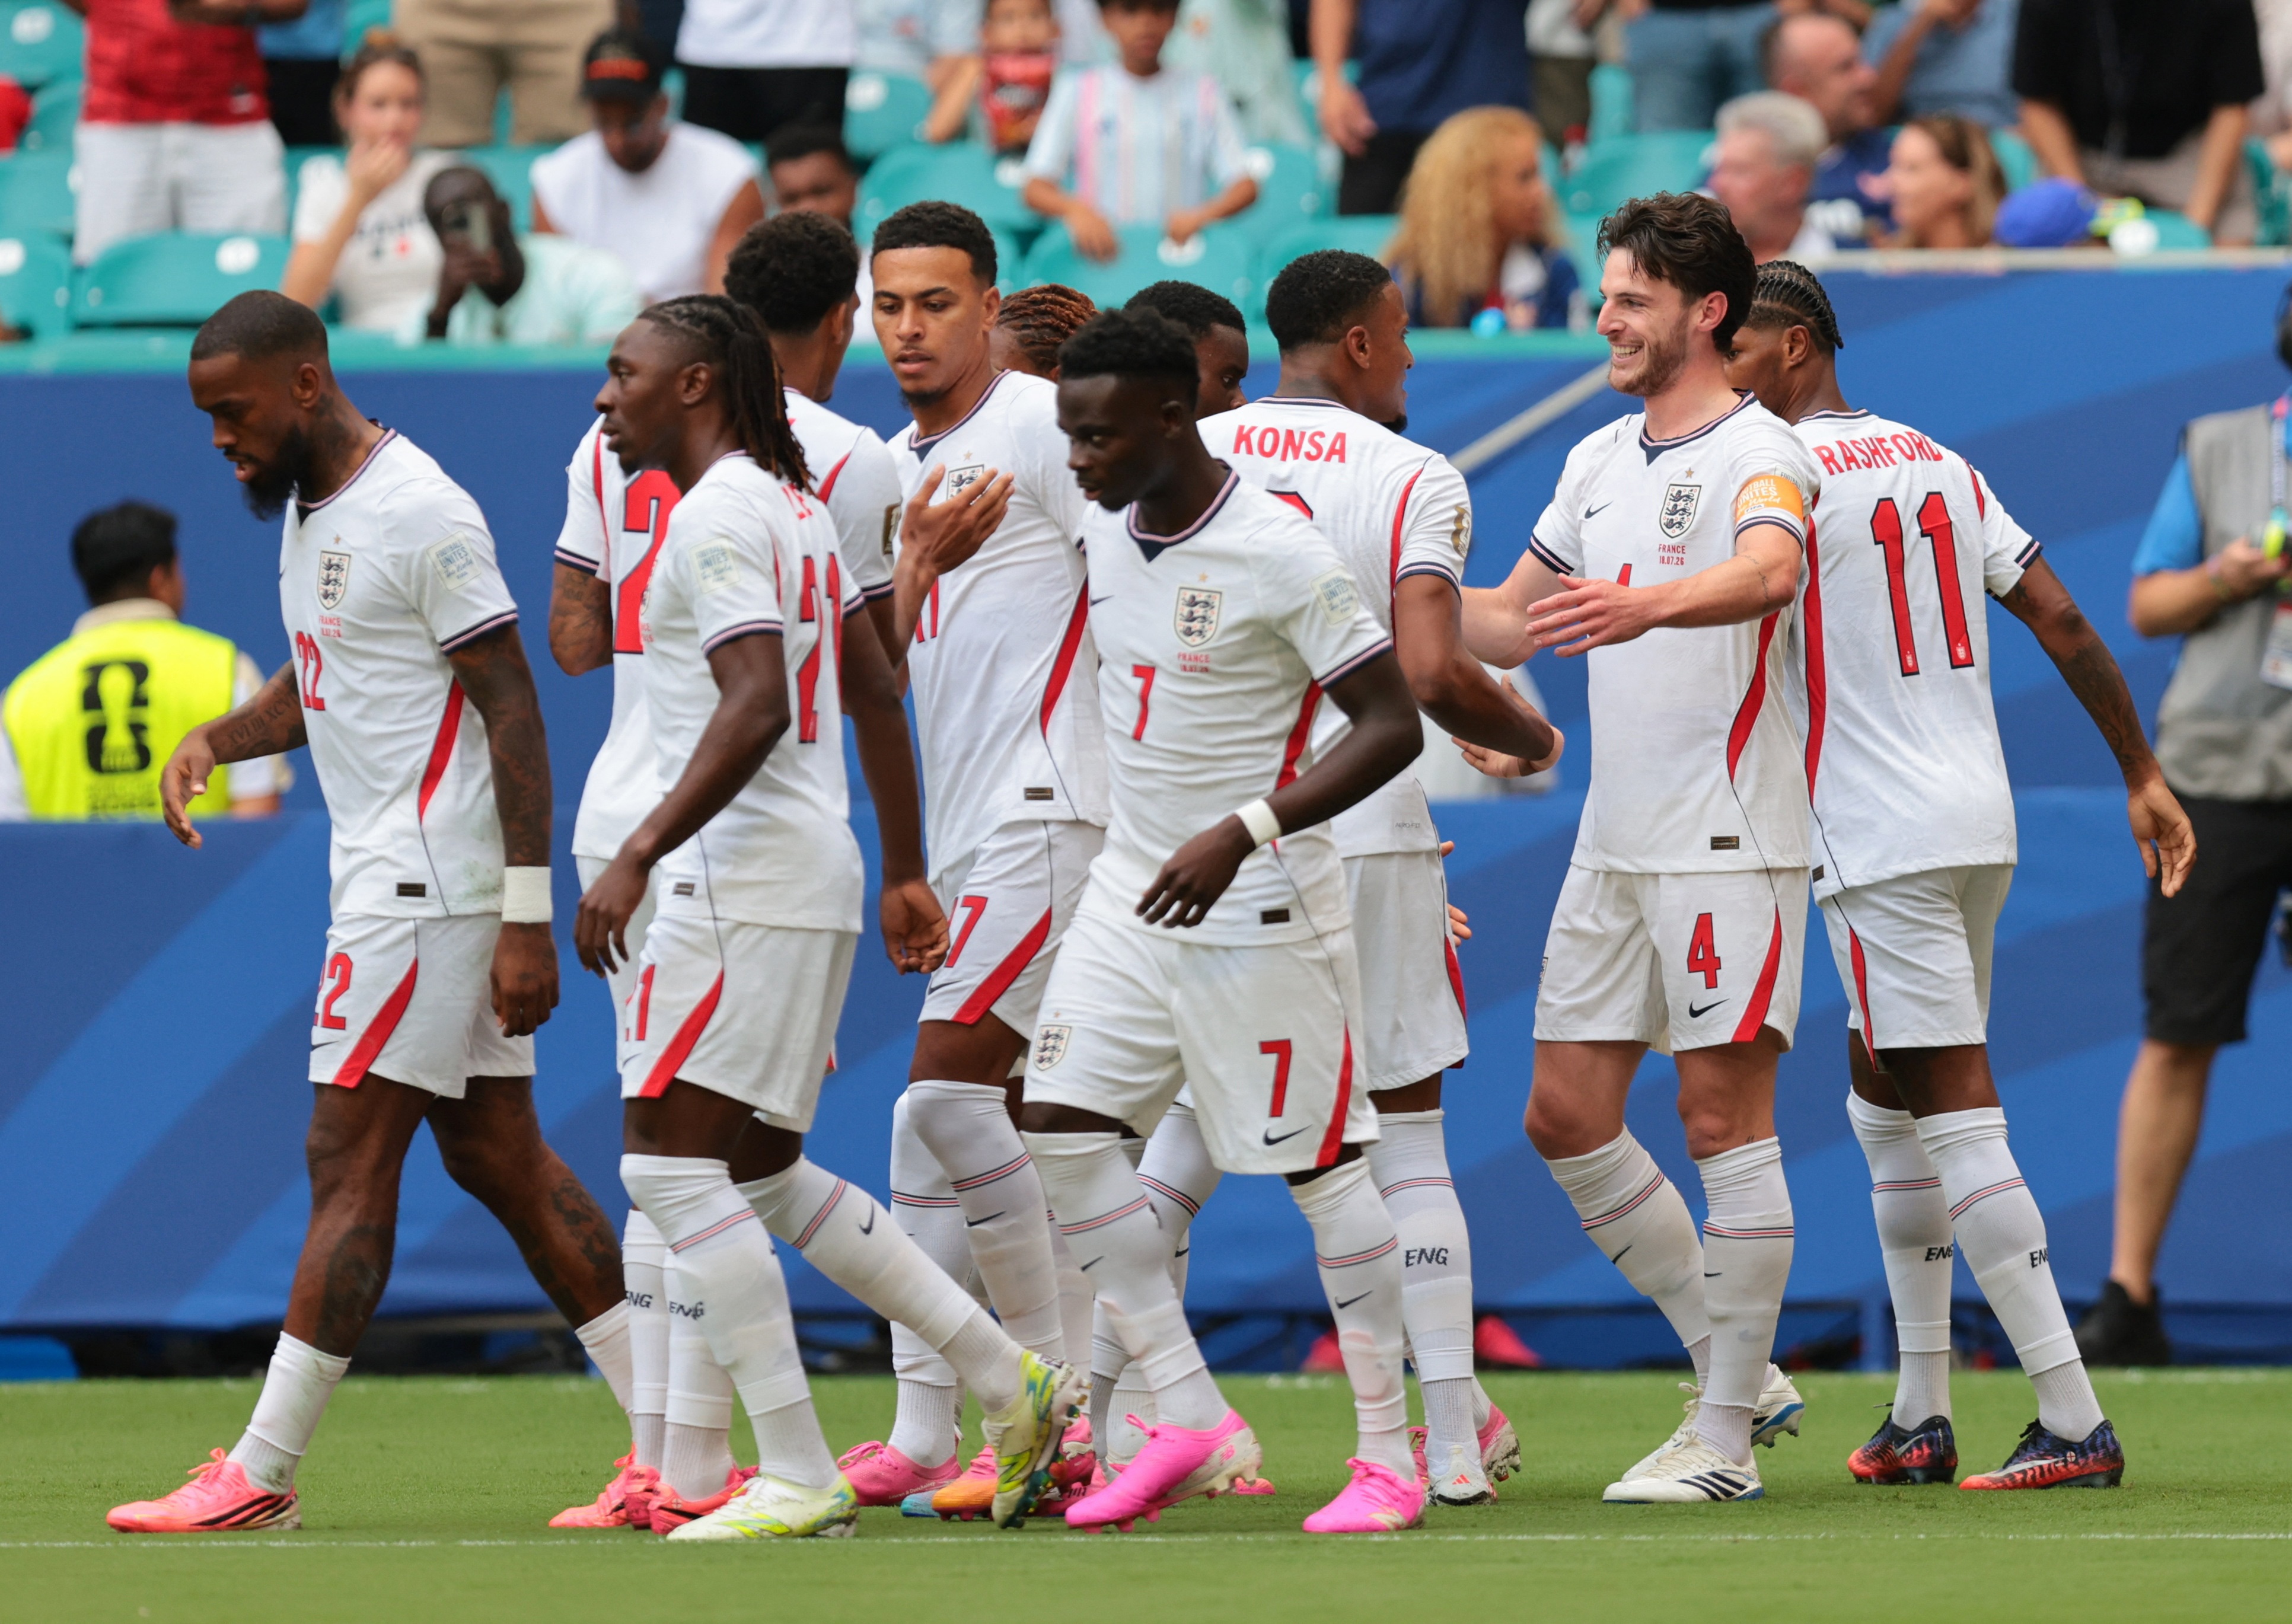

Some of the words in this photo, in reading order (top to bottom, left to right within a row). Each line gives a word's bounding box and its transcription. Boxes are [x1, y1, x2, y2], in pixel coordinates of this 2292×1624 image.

[1233, 425, 1347, 464] KONSA
[1812, 431, 1944, 476] RASHFORD
[439, 547, 468, 568] UNITES
[1658, 544, 1685, 554] FRANCE
[1659, 556, 1684, 566] 18.07.26
[1870, 491, 1975, 677] 11
[318, 614, 342, 626] FRANCE
[295, 631, 325, 712] 22
[1177, 652, 1210, 663] FRANCE
[1132, 665, 1155, 742] 7
[1687, 912, 1722, 990] 4
[314, 952, 353, 1030] 2
[625, 963, 655, 1042] 1
[1259, 1039, 1293, 1118] 7
[1405, 1247, 1449, 1268] ENG
[669, 1301, 705, 1320] ENG
